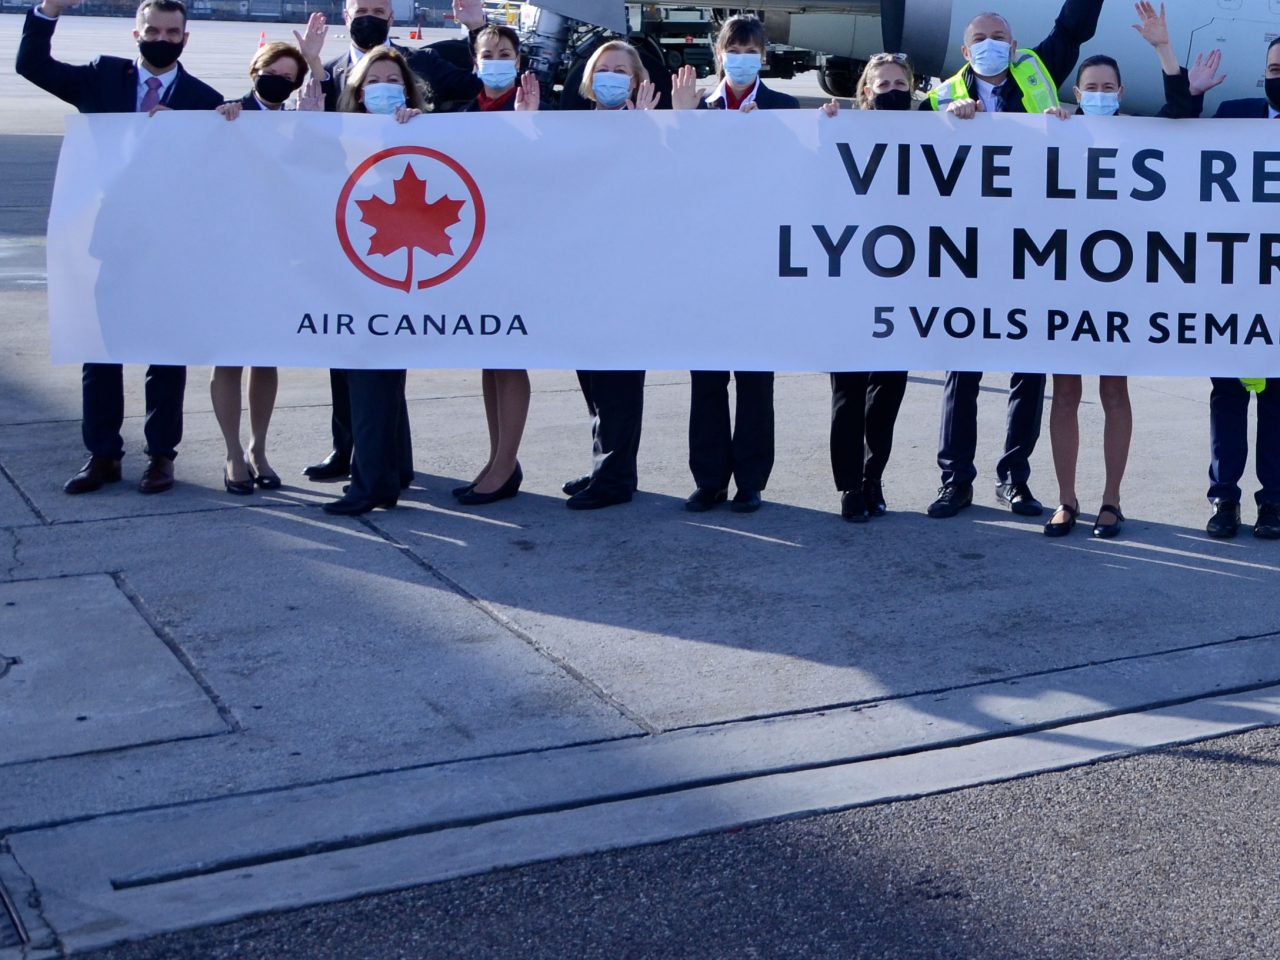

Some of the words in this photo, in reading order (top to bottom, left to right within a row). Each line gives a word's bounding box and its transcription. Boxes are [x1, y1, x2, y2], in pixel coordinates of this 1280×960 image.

[835, 142, 1013, 198] VIVE
[1045, 146, 1167, 202] LES
[778, 224, 979, 279] LYON
[296, 312, 356, 335] AIR
[367, 313, 528, 336] CANADA
[871, 306, 895, 339] 5
[908, 306, 1029, 341] VOLS
[1047, 309, 1131, 344] PAR
